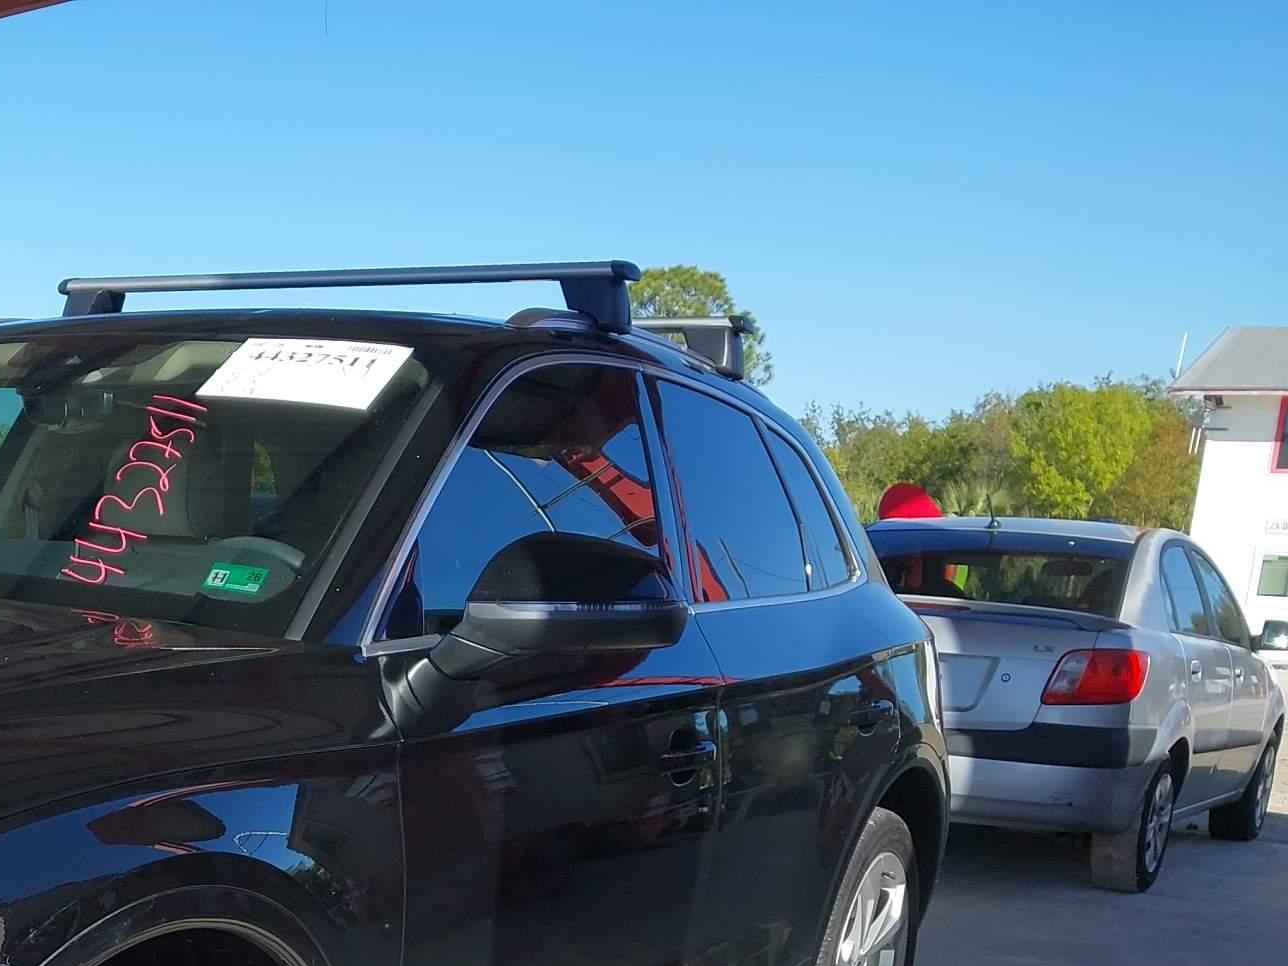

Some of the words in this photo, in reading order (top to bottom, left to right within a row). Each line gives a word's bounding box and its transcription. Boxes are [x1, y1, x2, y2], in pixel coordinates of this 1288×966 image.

[249, 350, 378, 367] 44327511
[61, 394, 208, 584] 44327511
[246, 572, 263, 583] 26
